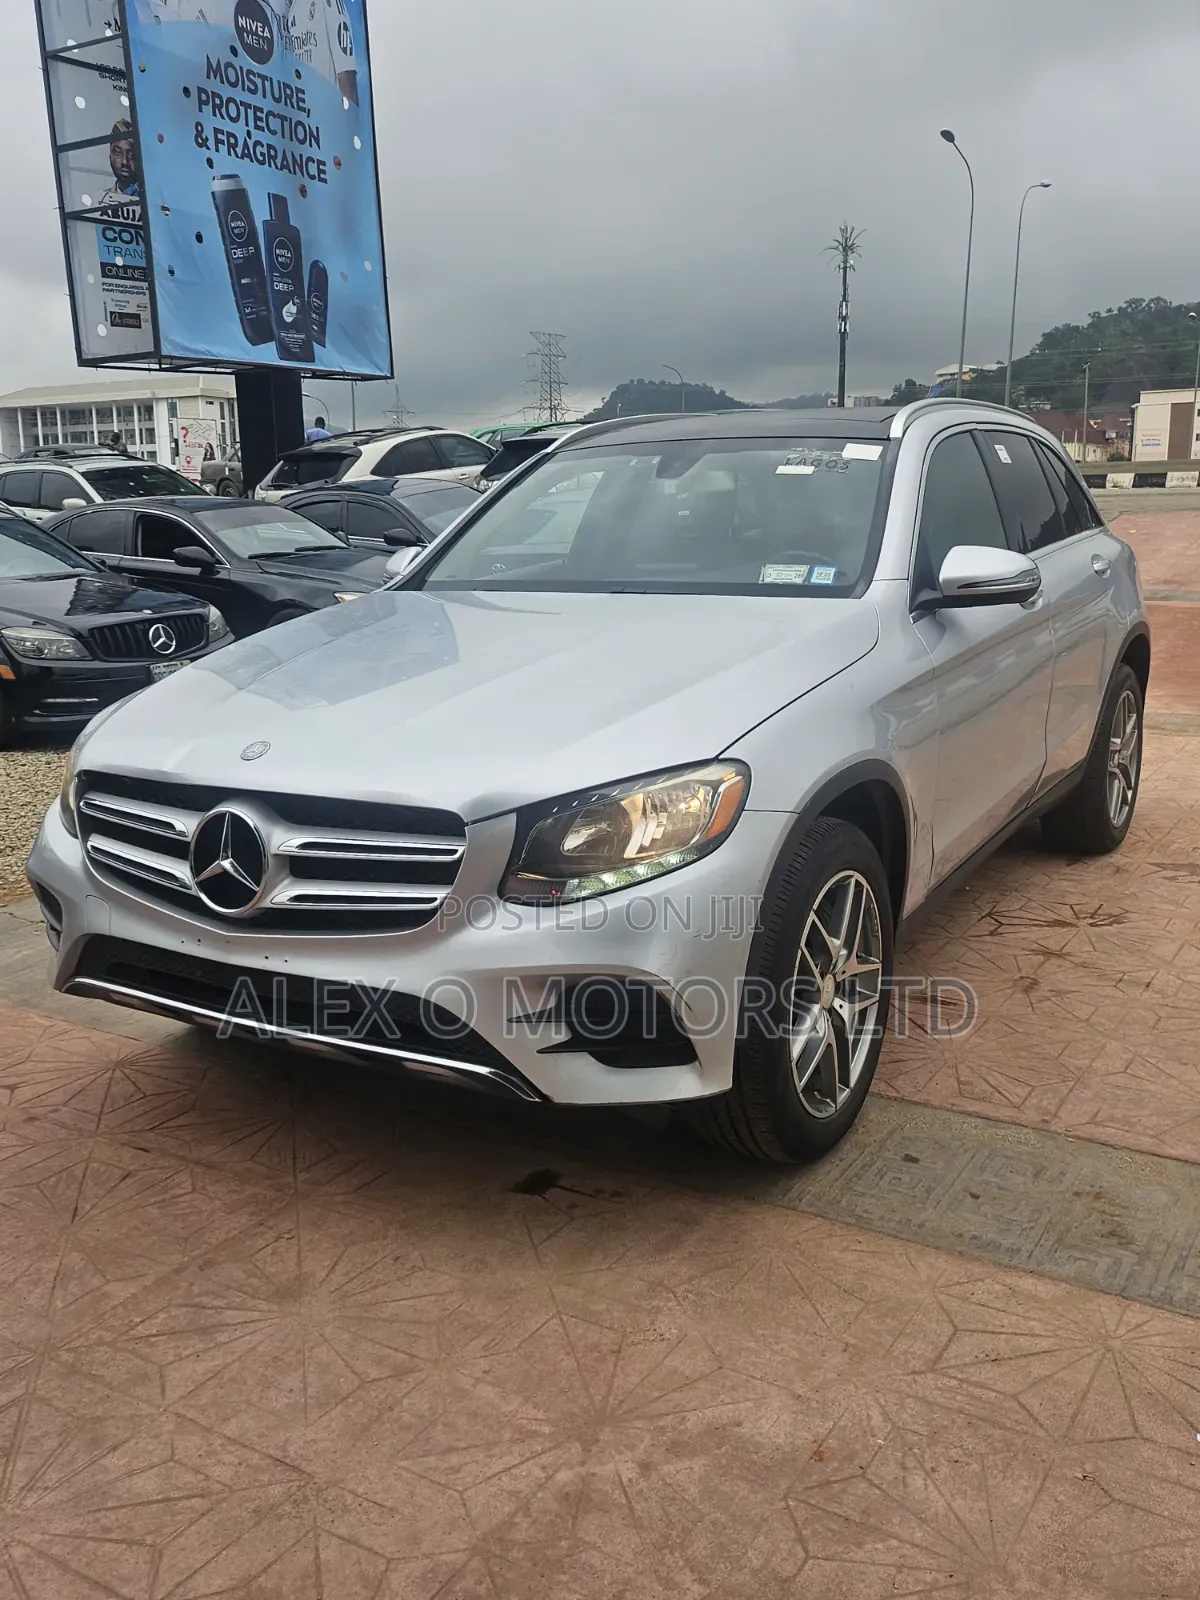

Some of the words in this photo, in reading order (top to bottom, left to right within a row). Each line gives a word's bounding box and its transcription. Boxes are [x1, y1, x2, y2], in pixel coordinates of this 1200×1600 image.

[237, 14, 271, 39] NIVEA
[243, 31, 268, 51] MEN
[206, 53, 311, 119] MOISTURE,
[196, 85, 321, 151] PROTECTION
[194, 120, 211, 151] &
[212, 126, 328, 185] FRAGRANCE
[231, 246, 255, 259] DEEP
[105, 266, 145, 279] ONLINE
[273, 282, 294, 291] DEEP
